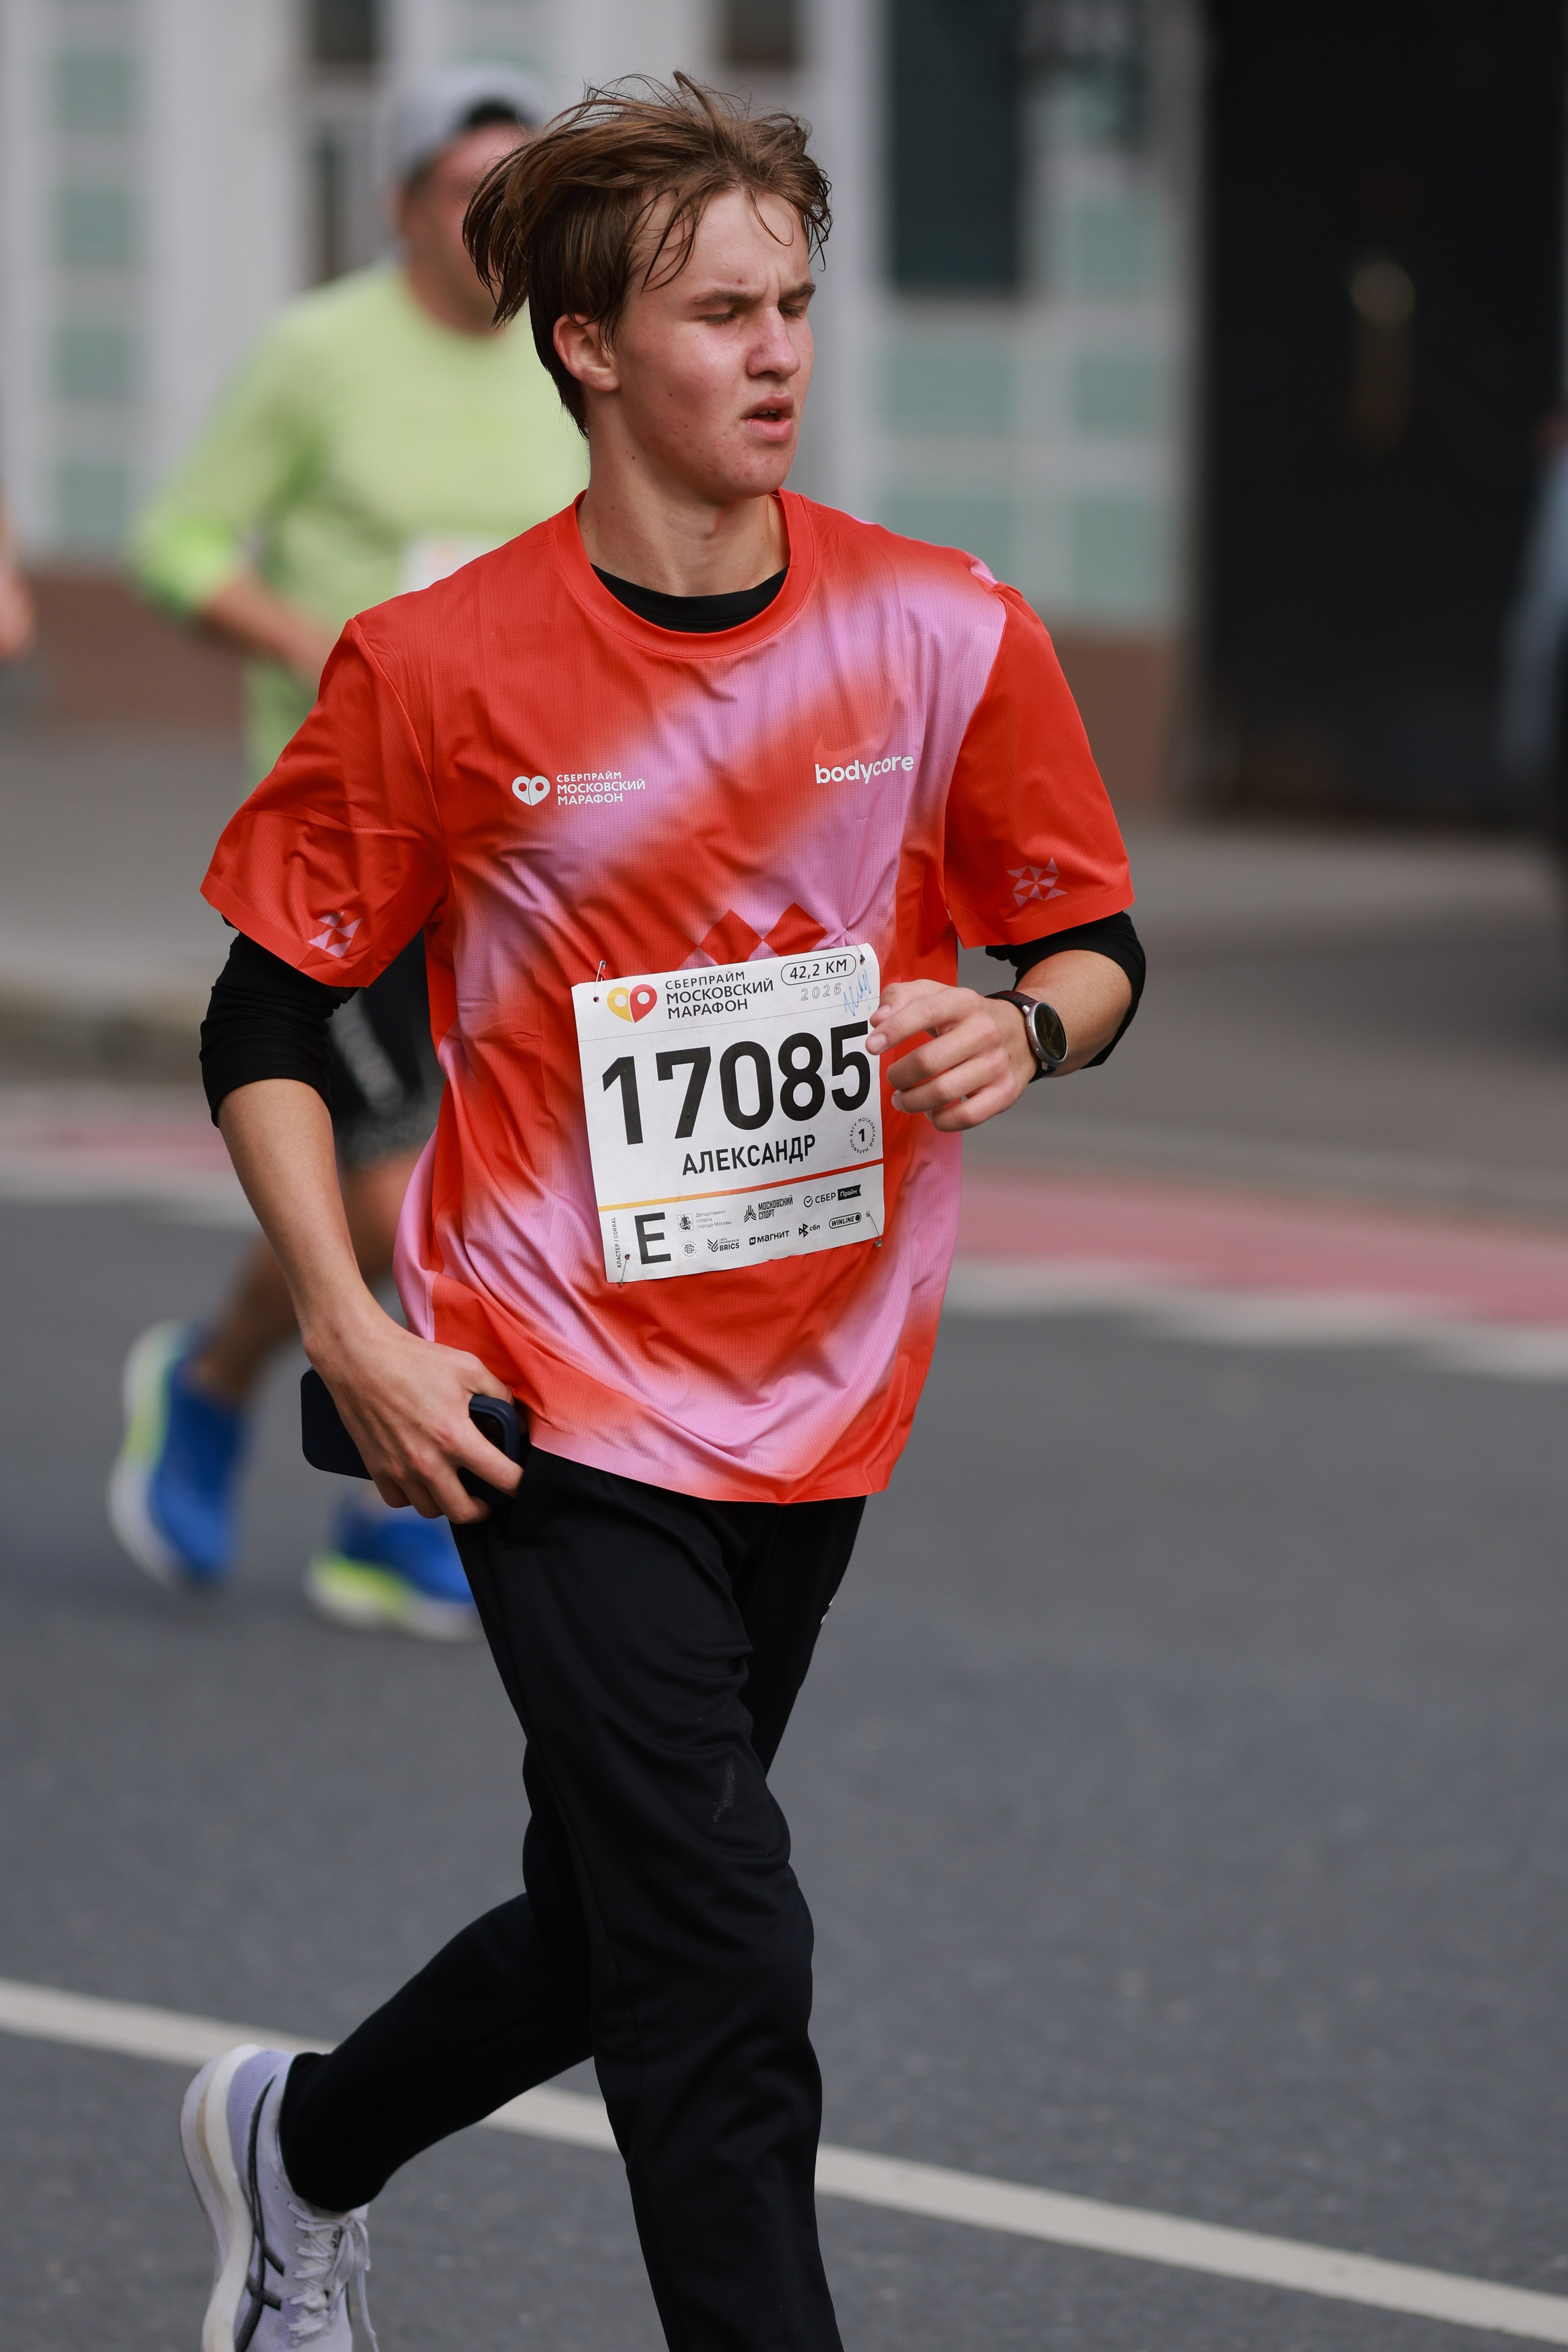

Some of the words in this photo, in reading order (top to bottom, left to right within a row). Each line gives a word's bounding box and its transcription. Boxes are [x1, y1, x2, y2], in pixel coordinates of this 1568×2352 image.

[556, 770, 622, 783] СБЕРПРАЙМ
[815, 755, 914, 784] bodycore
[557, 778, 646, 794] МОСКОВСКИЙ
[557, 793, 624, 805] МАРАФОН
[790, 963, 820, 979] 42,2
[826, 959, 846, 974] КМ
[665, 971, 745, 990] СБЕРПРАЙМ
[666, 978, 774, 1005] МОСКОВСКИЙ
[801, 982, 842, 1001] 2026
[668, 998, 748, 1019] МАРАФОН
[602, 1020, 871, 1145] 17085
[858, 1128, 865, 1142] 1
[682, 1134, 816, 1176] АЛЕКСАНДР
[758, 1194, 793, 1212] МОСКОВСКИЙ
[815, 1192, 836, 1204] СБЕР
[840, 1189, 858, 1197] Прайм
[695, 1210, 726, 1218] Департамент
[758, 1208, 775, 1220] СПОРТ
[831, 1215, 855, 1227] WINLINE
[719, 1242, 740, 1251] BRICS
